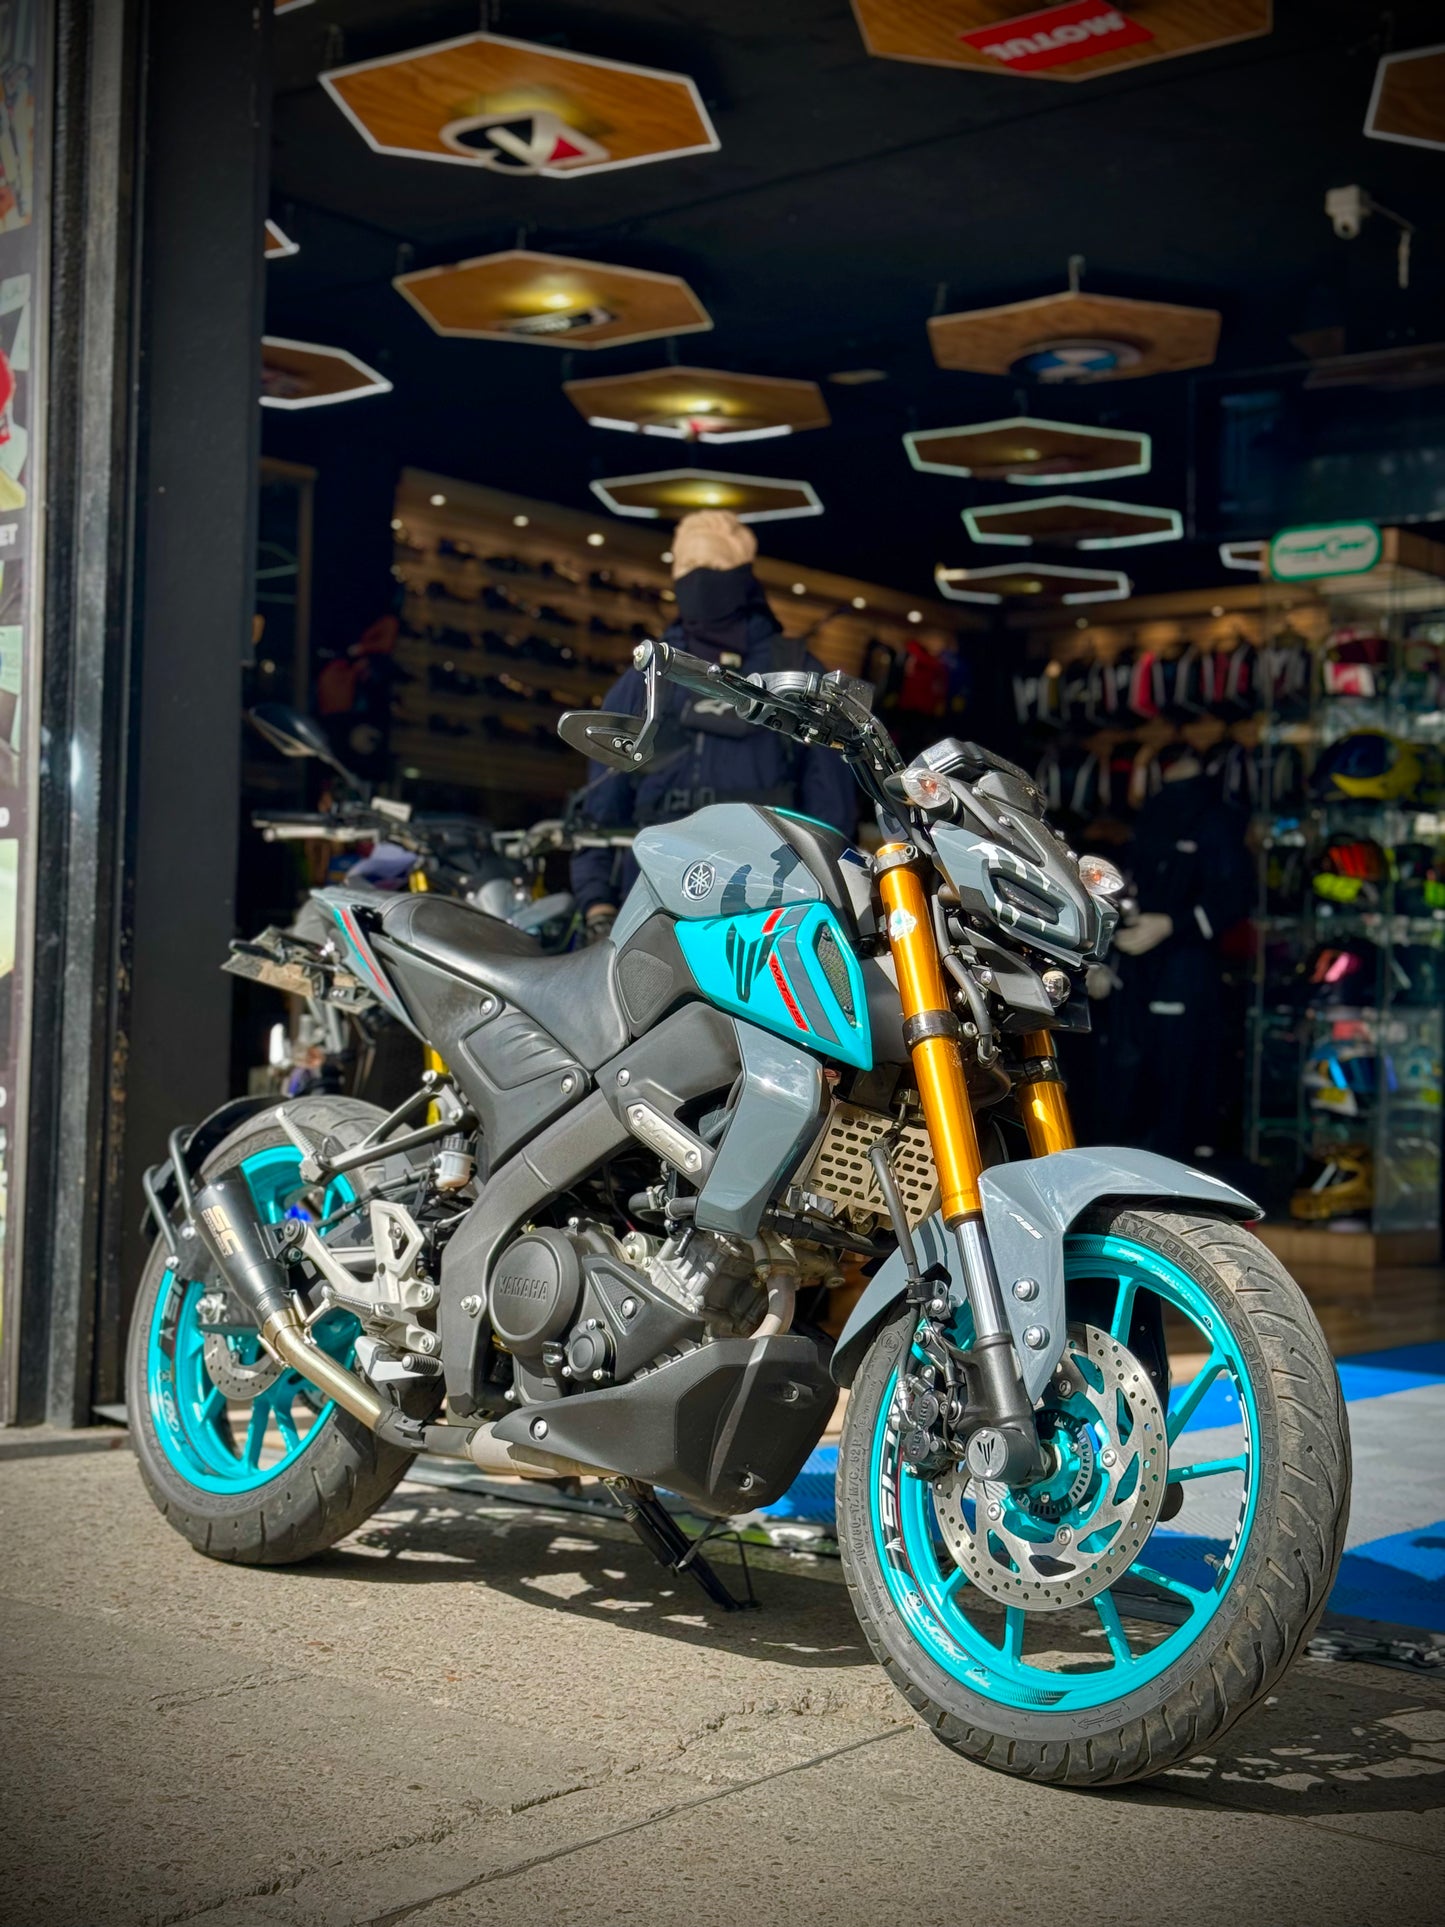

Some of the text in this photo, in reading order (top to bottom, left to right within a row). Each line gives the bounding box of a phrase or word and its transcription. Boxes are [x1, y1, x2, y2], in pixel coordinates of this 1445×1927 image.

[980, 11, 1127, 62] MOTUL
[771, 963, 802, 1025] MT-15
[206, 1204, 245, 1256] SC
[499, 1275, 550, 1302] YAMAHA
